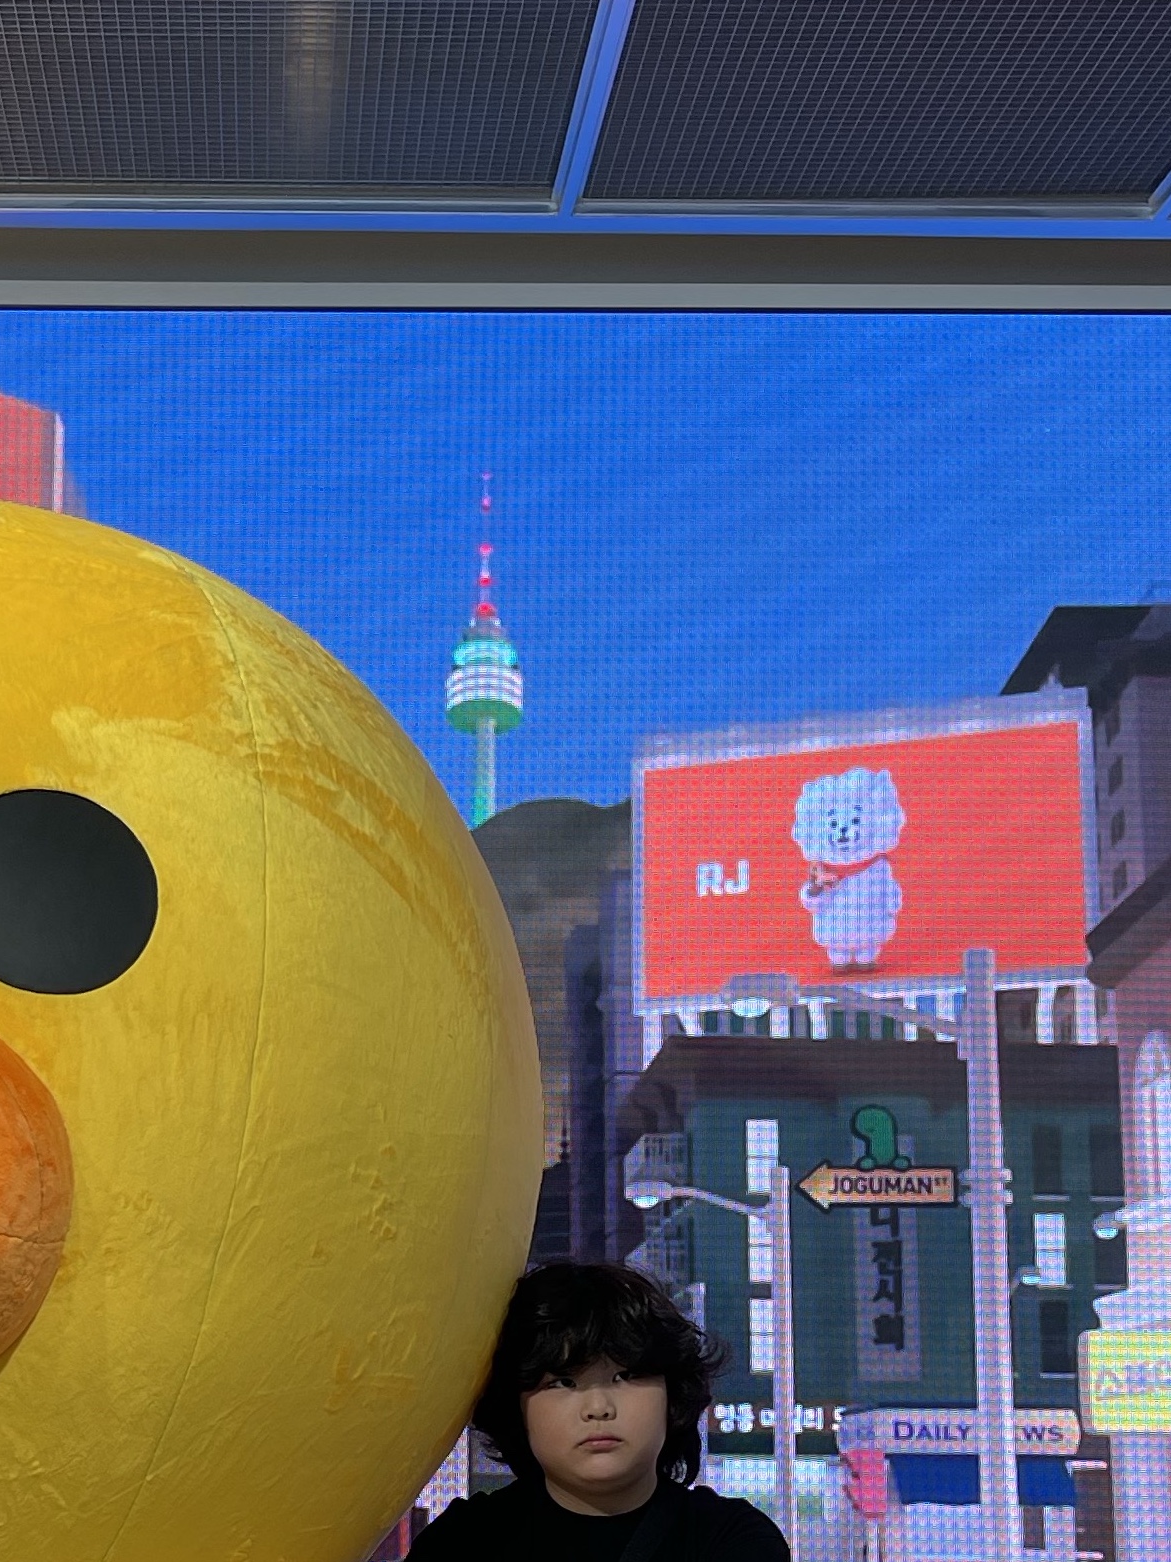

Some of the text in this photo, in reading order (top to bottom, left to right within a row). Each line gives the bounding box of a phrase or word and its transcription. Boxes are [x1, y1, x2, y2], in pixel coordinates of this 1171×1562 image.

[696, 860, 749, 897] RJ
[828, 1174, 933, 1195] JOGUMAN
[893, 1420, 971, 1441] DAILY
[1022, 1426, 1065, 1443] WS
